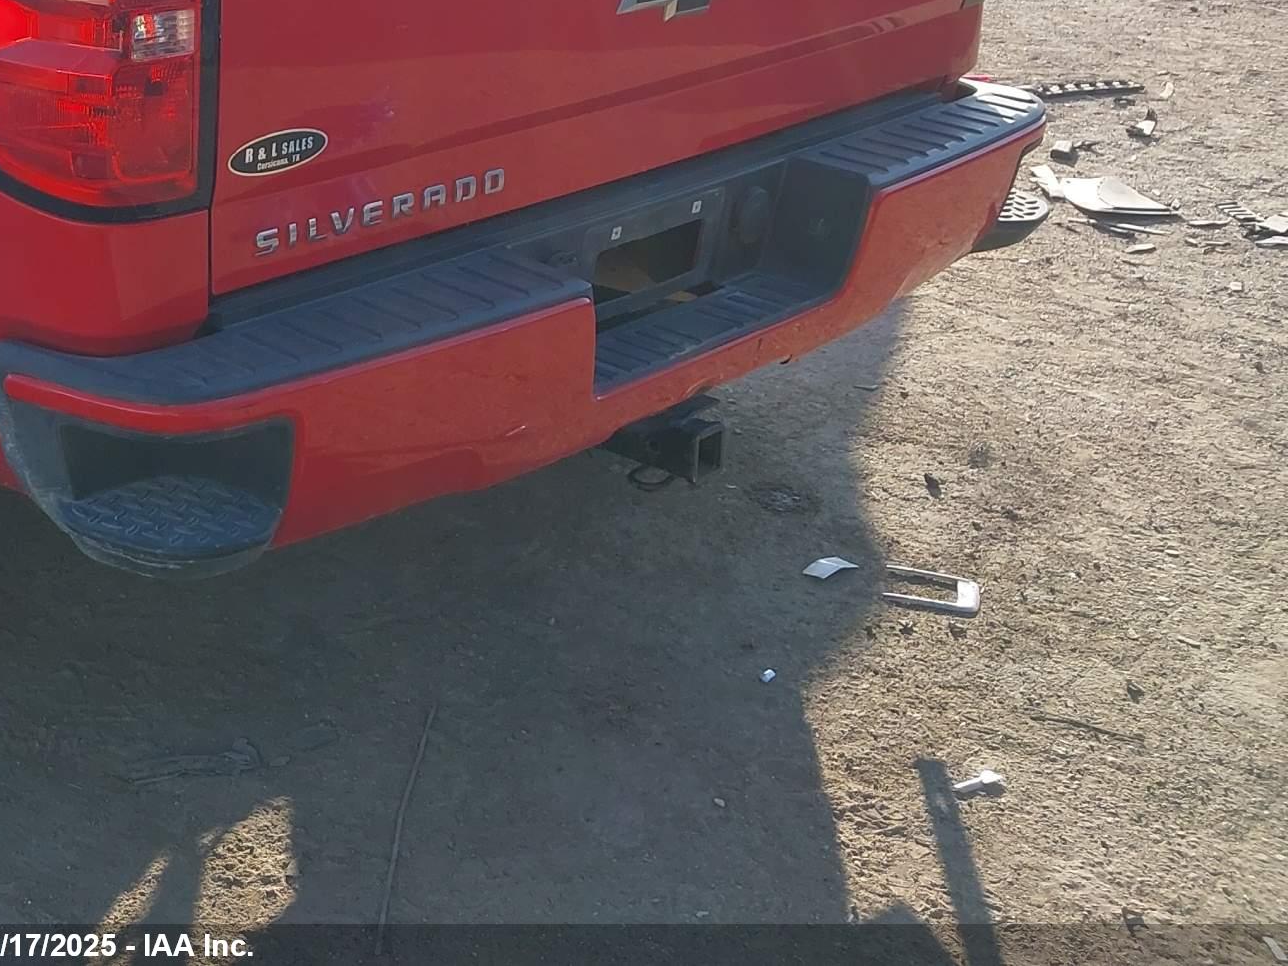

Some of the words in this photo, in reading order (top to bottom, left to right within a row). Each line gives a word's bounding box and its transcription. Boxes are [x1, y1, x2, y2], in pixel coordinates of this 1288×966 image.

[245, 148, 254, 163] R
[257, 147, 267, 161] &
[271, 142, 278, 157] L
[281, 136, 314, 155] SALES
[254, 167, 507, 256] SILVERADO
